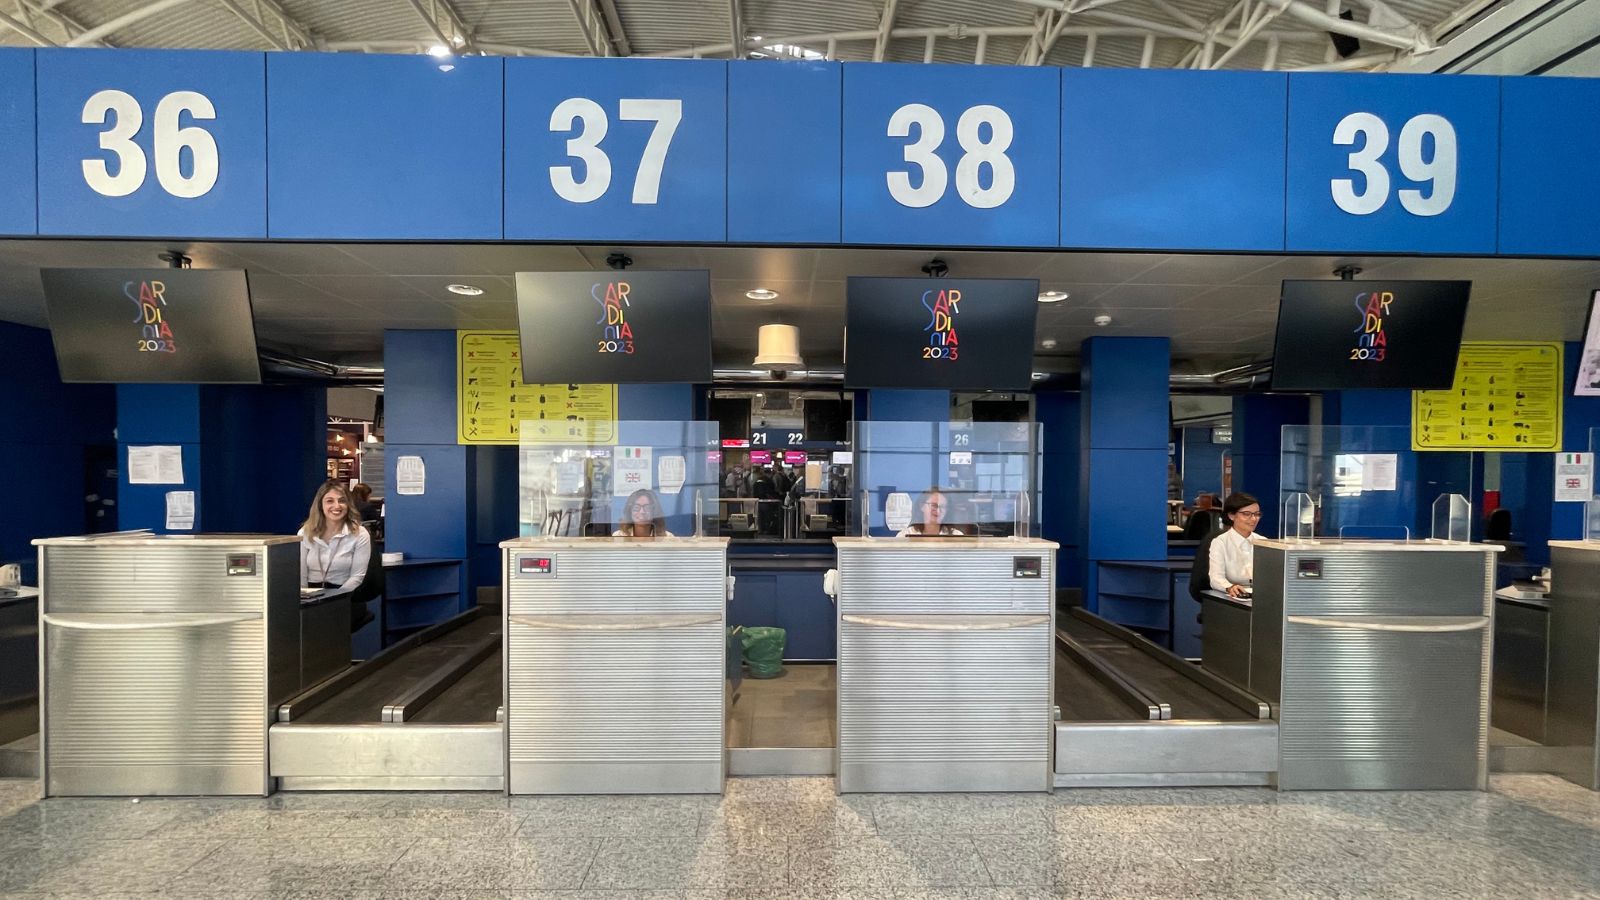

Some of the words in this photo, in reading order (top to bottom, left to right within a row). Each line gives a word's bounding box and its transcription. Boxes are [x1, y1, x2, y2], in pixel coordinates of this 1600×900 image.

[81, 89, 219, 199] 36
[549, 97, 683, 205] 37
[886, 103, 1016, 210] 38
[1331, 112, 1457, 217] 39
[138, 340, 176, 352] 2023
[598, 340, 634, 353] 2023
[923, 347, 958, 360] 2023
[1350, 348, 1385, 361] 2023
[752, 432, 767, 445] 21
[787, 432, 803, 445] 22
[954, 433, 969, 446] 26
